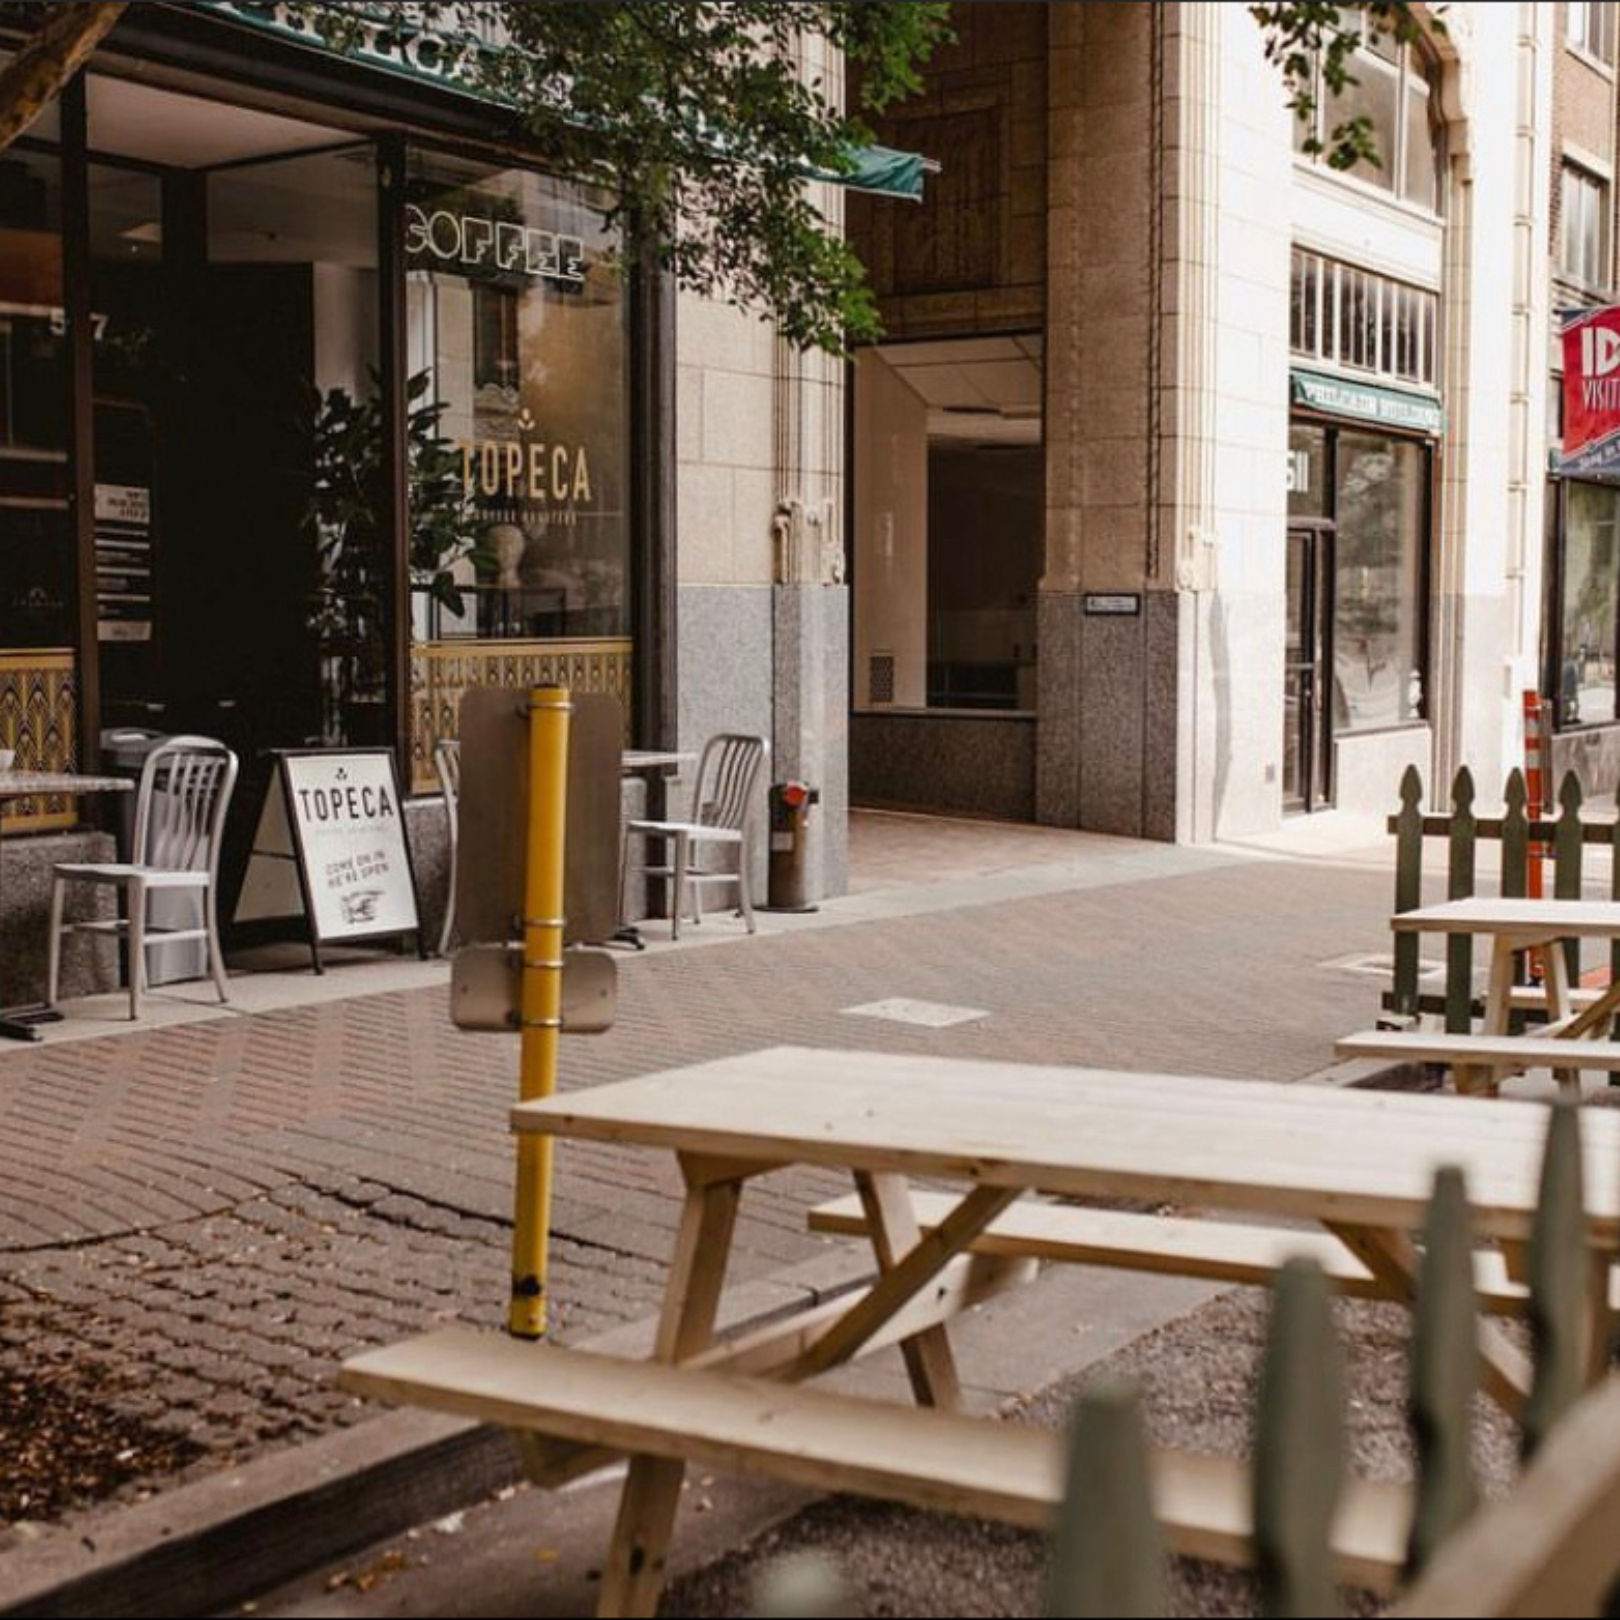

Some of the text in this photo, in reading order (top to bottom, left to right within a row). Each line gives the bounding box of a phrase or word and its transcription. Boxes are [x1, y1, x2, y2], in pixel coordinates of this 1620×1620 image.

[1582, 378, 1620, 412] VISIT
[459, 438, 592, 502] TOPECA
[298, 785, 394, 822] TOPECA
